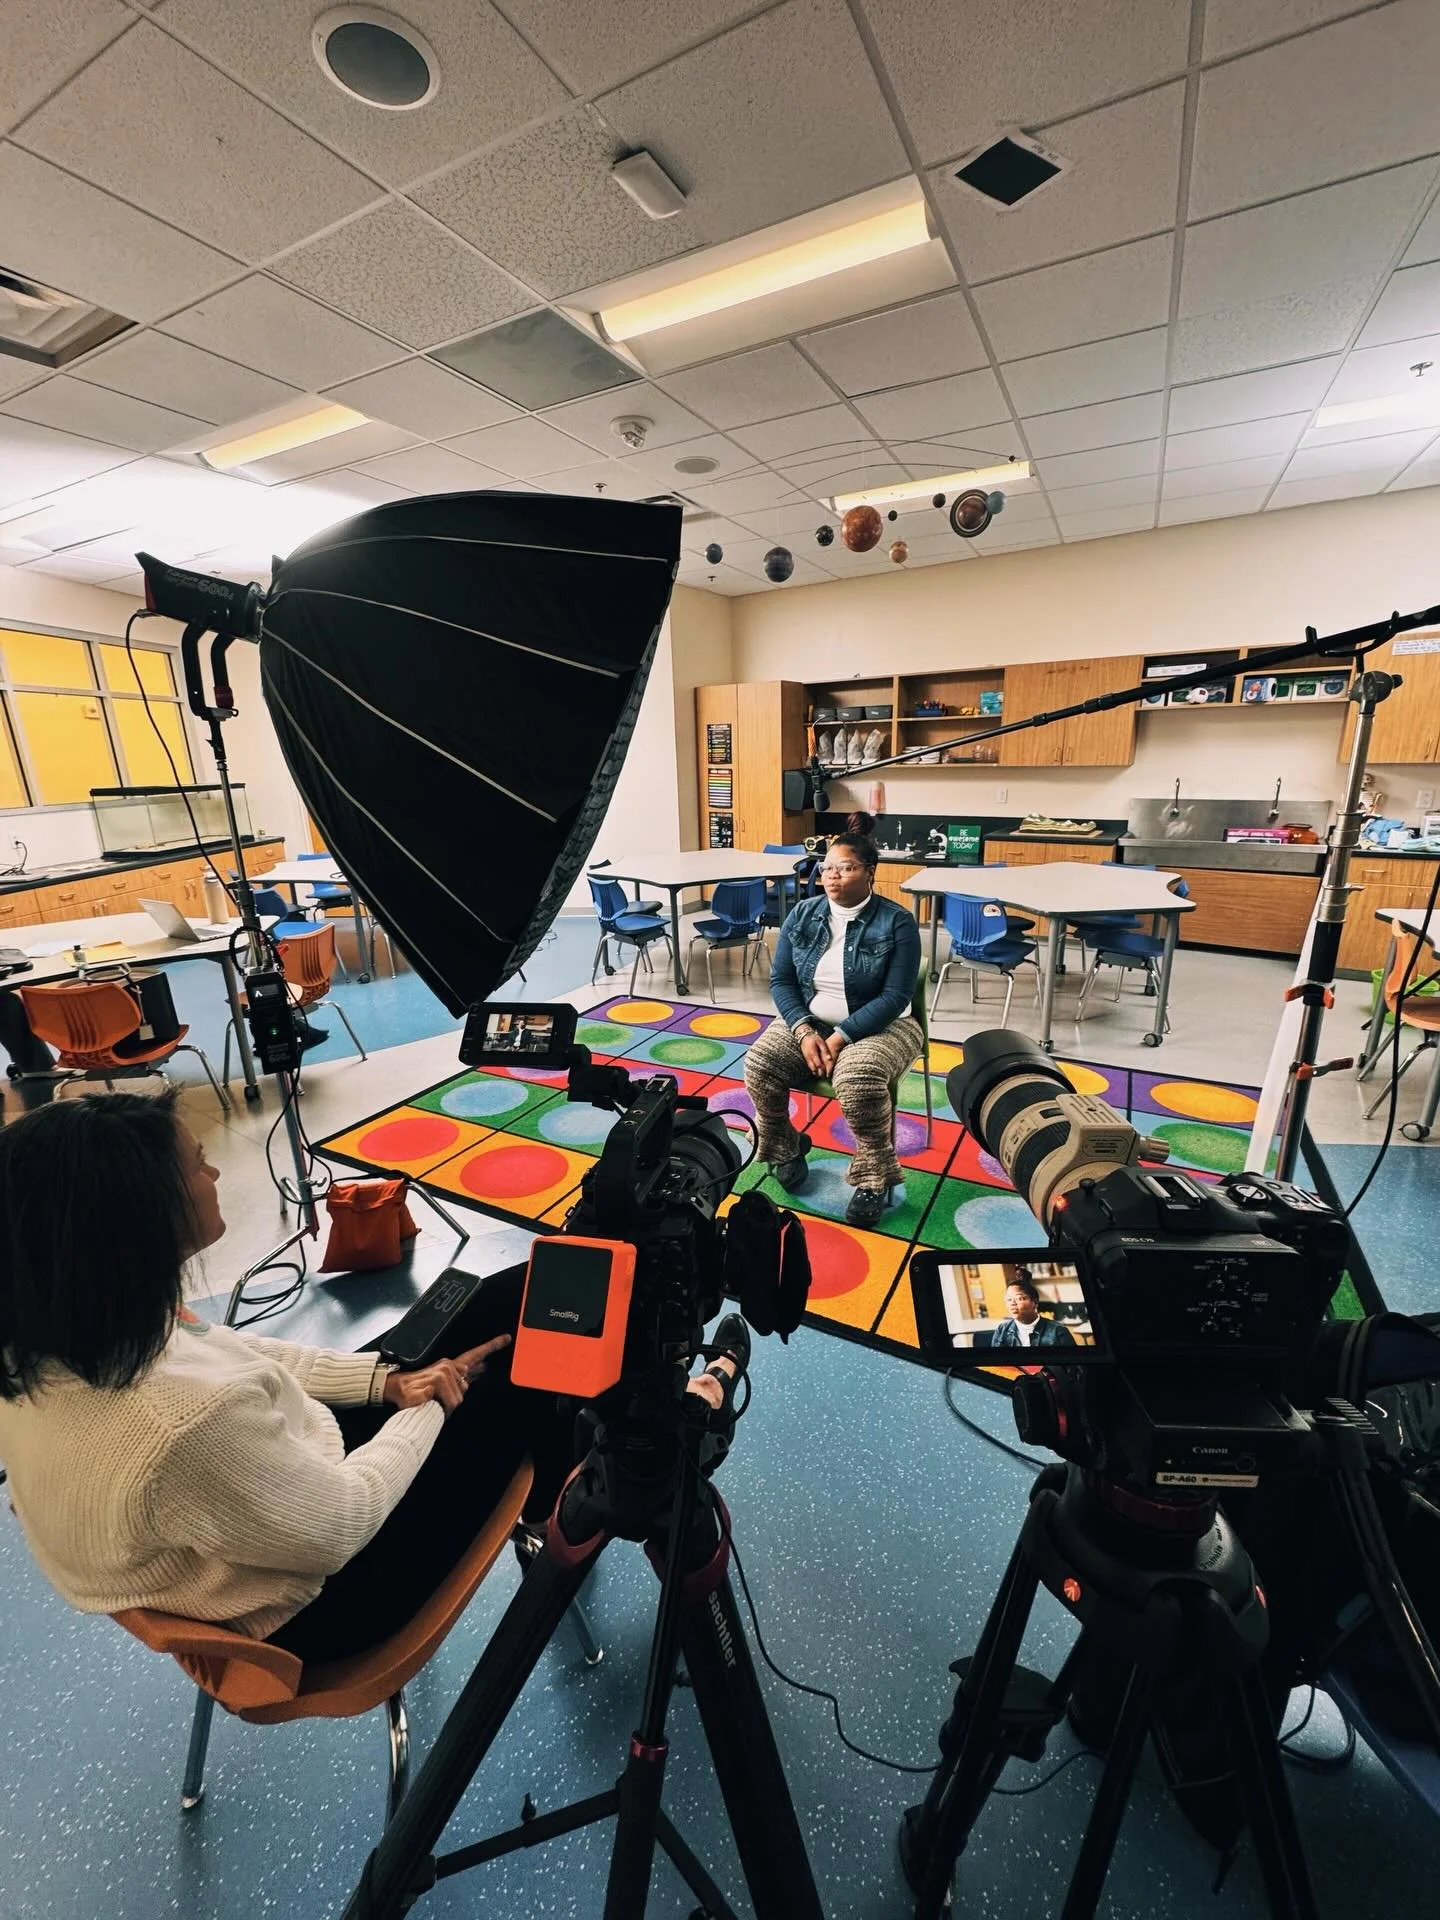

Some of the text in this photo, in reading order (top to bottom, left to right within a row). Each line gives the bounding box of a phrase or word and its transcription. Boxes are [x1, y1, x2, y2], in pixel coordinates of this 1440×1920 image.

[959, 829, 968, 837] BE
[952, 841, 975, 850] TODAY
[550, 1308, 580, 1322] SmallRig
[1191, 1446, 1229, 1455] Canon
[1162, 1474, 1197, 1484] BP-A60
[707, 1590, 738, 1669] sachtler
